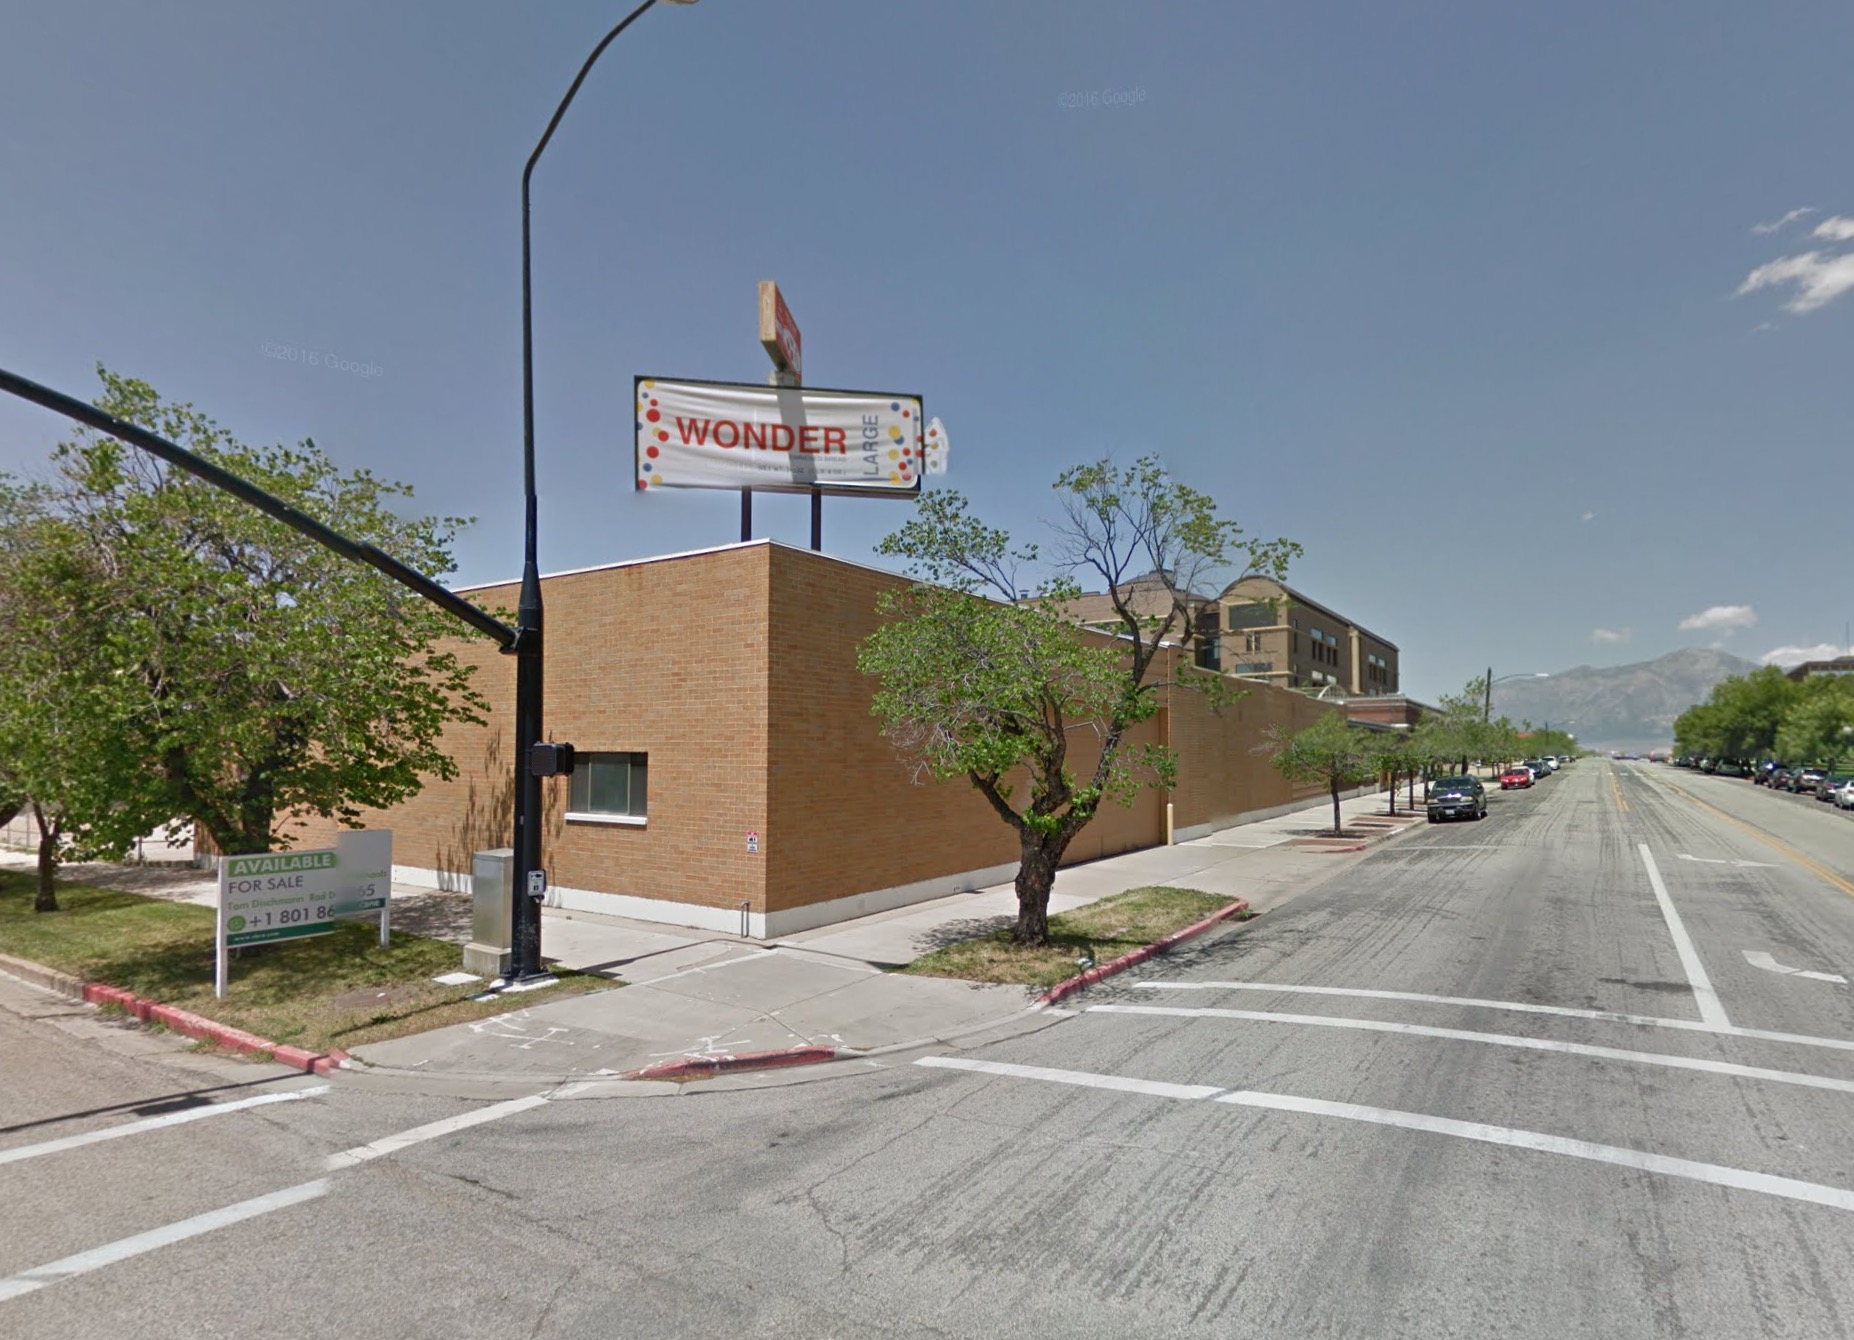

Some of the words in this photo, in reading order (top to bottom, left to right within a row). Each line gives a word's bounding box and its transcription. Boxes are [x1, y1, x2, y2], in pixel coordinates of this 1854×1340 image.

[675, 416, 847, 455] WONDER
[862, 414, 879, 476] LARGE
[234, 855, 331, 875] AVAILABLE
[228, 880, 262, 894] FOR
[267, 875, 303, 890] SALE
[249, 912, 272, 928] +1
[280, 908, 309, 924] 801
